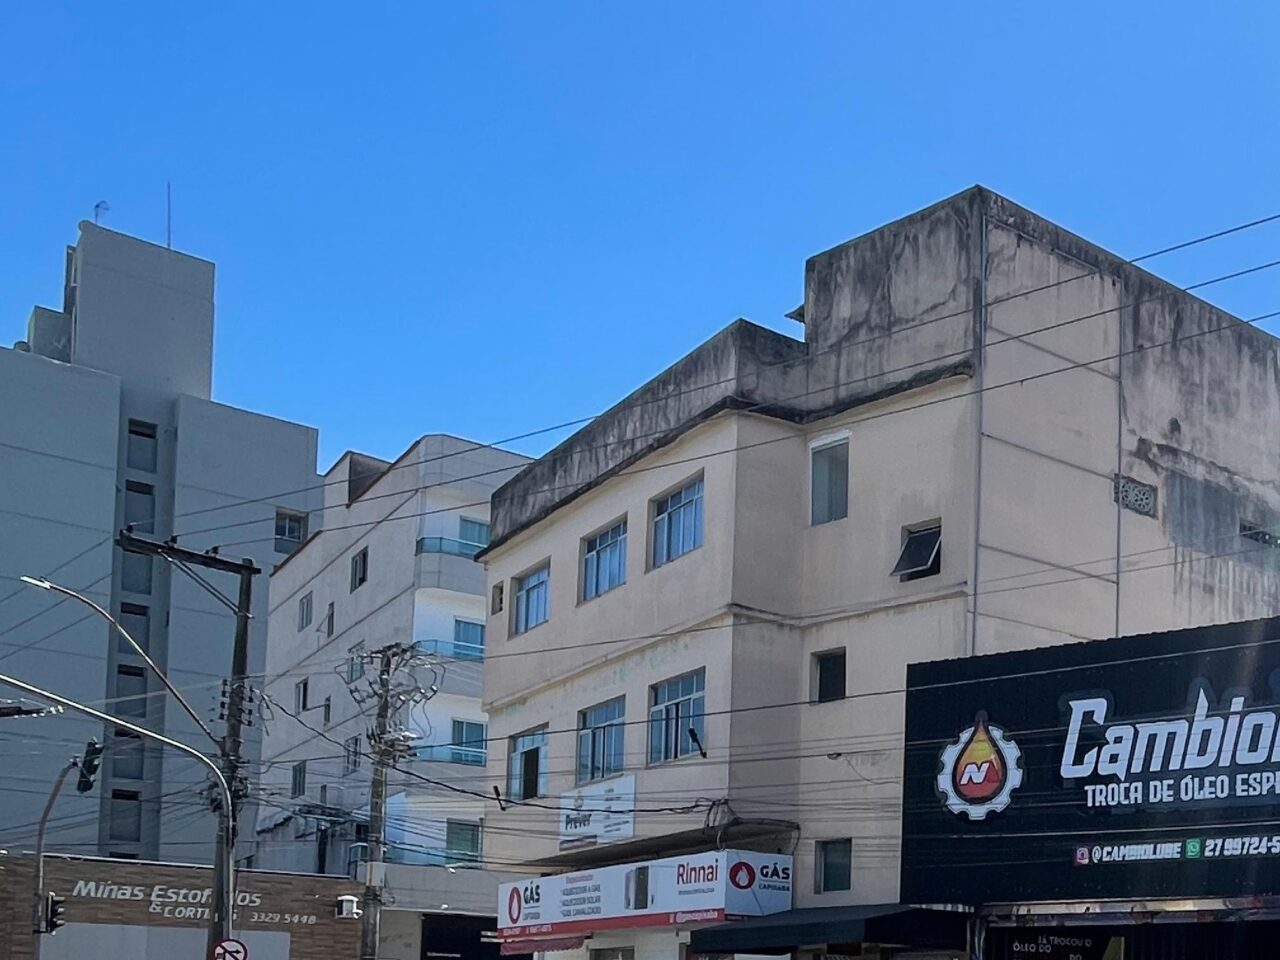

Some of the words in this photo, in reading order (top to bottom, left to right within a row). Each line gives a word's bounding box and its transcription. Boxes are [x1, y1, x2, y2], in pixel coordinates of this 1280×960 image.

[1084, 781, 1143, 807] TROCA
[1149, 779, 1174, 803] DE
[1180, 774, 1230, 801] ÓLEO
[1204, 838, 1222, 857] 27
[676, 858, 719, 885] Rinnai
[760, 862, 790, 880] GÁS
[72, 880, 145, 901] Minas
[150, 884, 262, 907] Estofos
[523, 880, 541, 905] GÁS
[249, 911, 280, 923] 3329
[1039, 944, 1052, 953] DO
